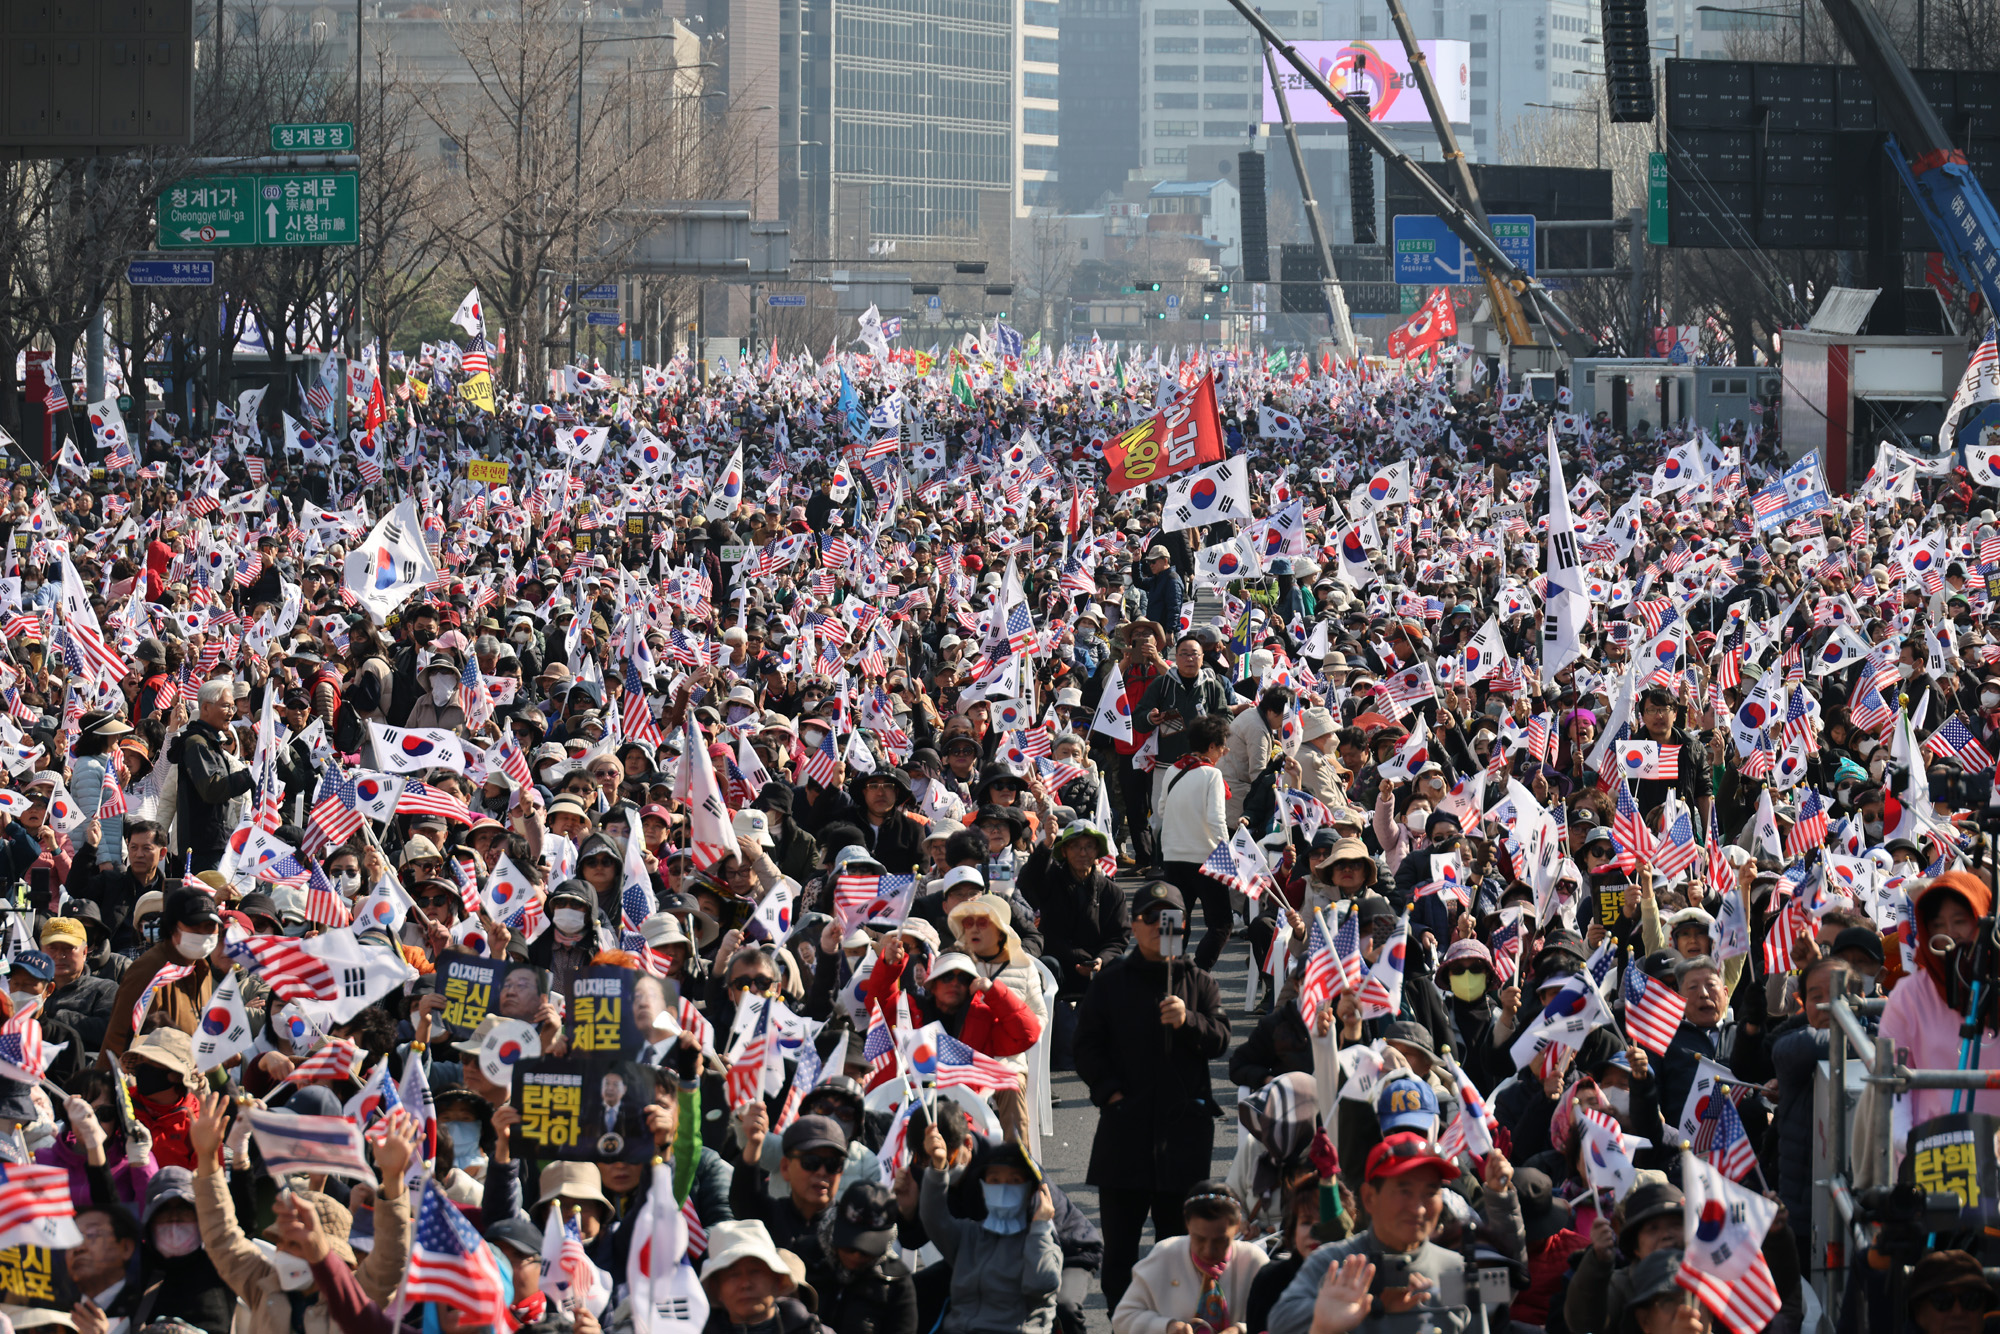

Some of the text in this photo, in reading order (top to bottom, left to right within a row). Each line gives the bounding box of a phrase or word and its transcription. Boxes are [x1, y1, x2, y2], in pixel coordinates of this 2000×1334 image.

[280, 128, 343, 145] 청계광장
[266, 187, 278, 197] 60
[283, 178, 337, 197] 숭례문
[170, 187, 238, 208] 청계1가
[171, 209, 217, 224] Cheonggye
[285, 214, 319, 232] 시청
[285, 231, 328, 243] City Hall
[1498, 238, 1530, 248] 소문로
[172, 263, 210, 274] 청계천로
[1403, 254, 1431, 264] 소공로
[472, 464, 488, 478] 충북
[1601, 911, 1620, 926] 각
[22, 955, 49, 970] ORT
[448, 961, 494, 983] 이재명
[444, 977, 492, 1008] 즉시
[573, 978, 622, 997] 이재명
[442, 1000, 487, 1029] 체포
[573, 997, 622, 1024] 즉시
[571, 1023, 622, 1052] 체포
[522, 1085, 582, 1116] 탄핵
[1391, 1089, 1421, 1113] KS
[521, 1115, 582, 1146] 각하
[1915, 1143, 1977, 1183] 탄핵
[0, 1265, 55, 1301] 체포
